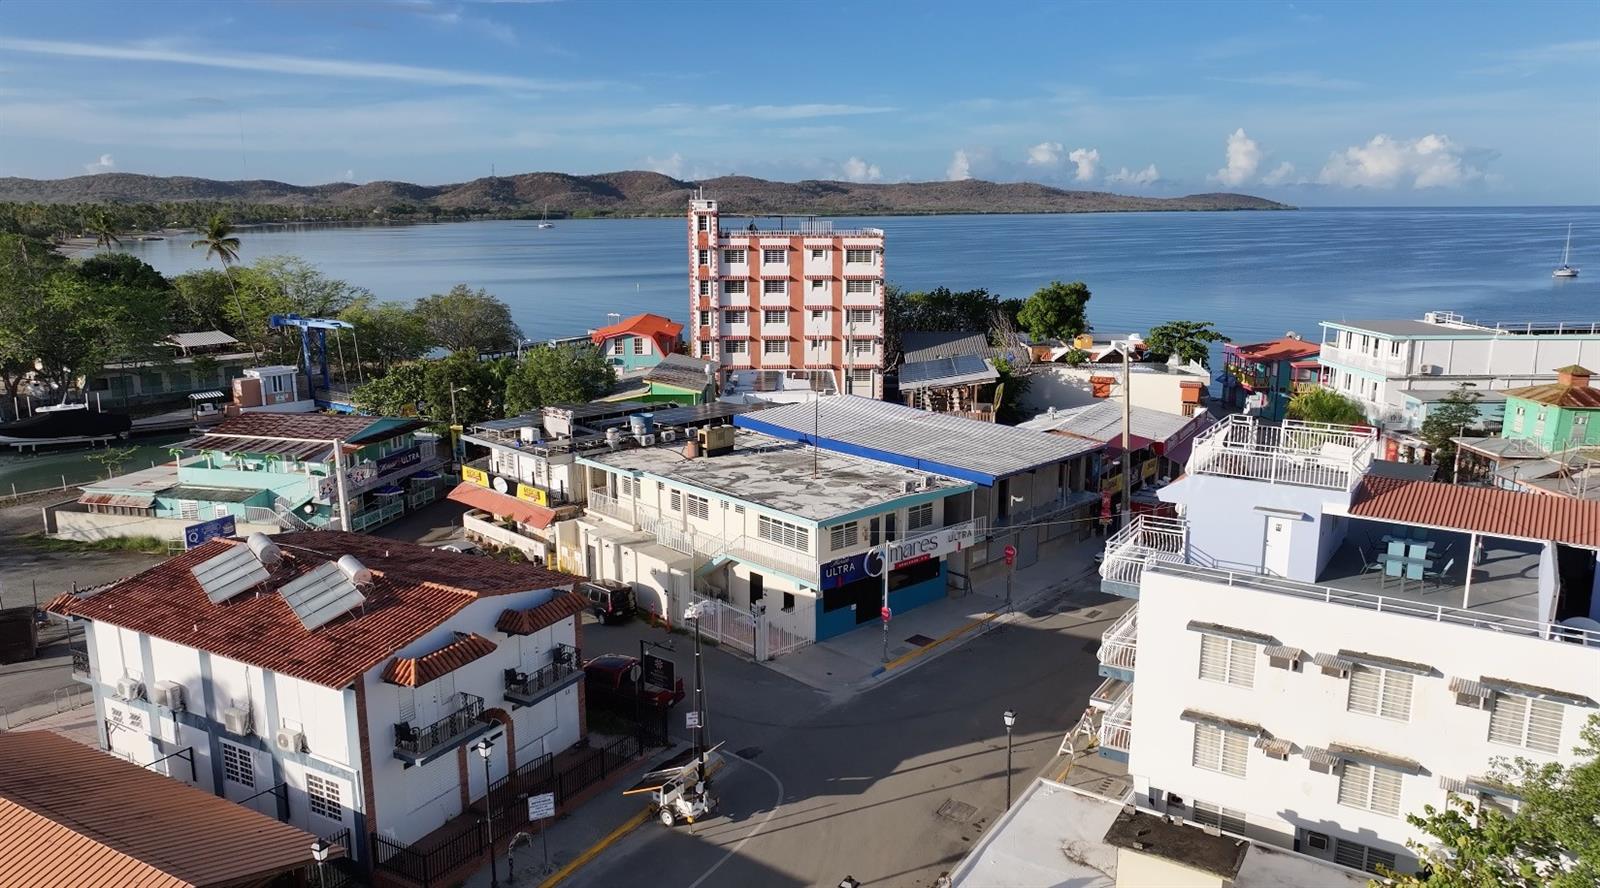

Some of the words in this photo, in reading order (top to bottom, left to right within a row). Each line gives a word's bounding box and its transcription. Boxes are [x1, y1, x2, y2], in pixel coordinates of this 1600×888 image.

[401, 452, 420, 464] ULTRA
[948, 530, 972, 543] ULTRA
[889, 535, 938, 562] mares
[825, 562, 856, 578] ULTRA
